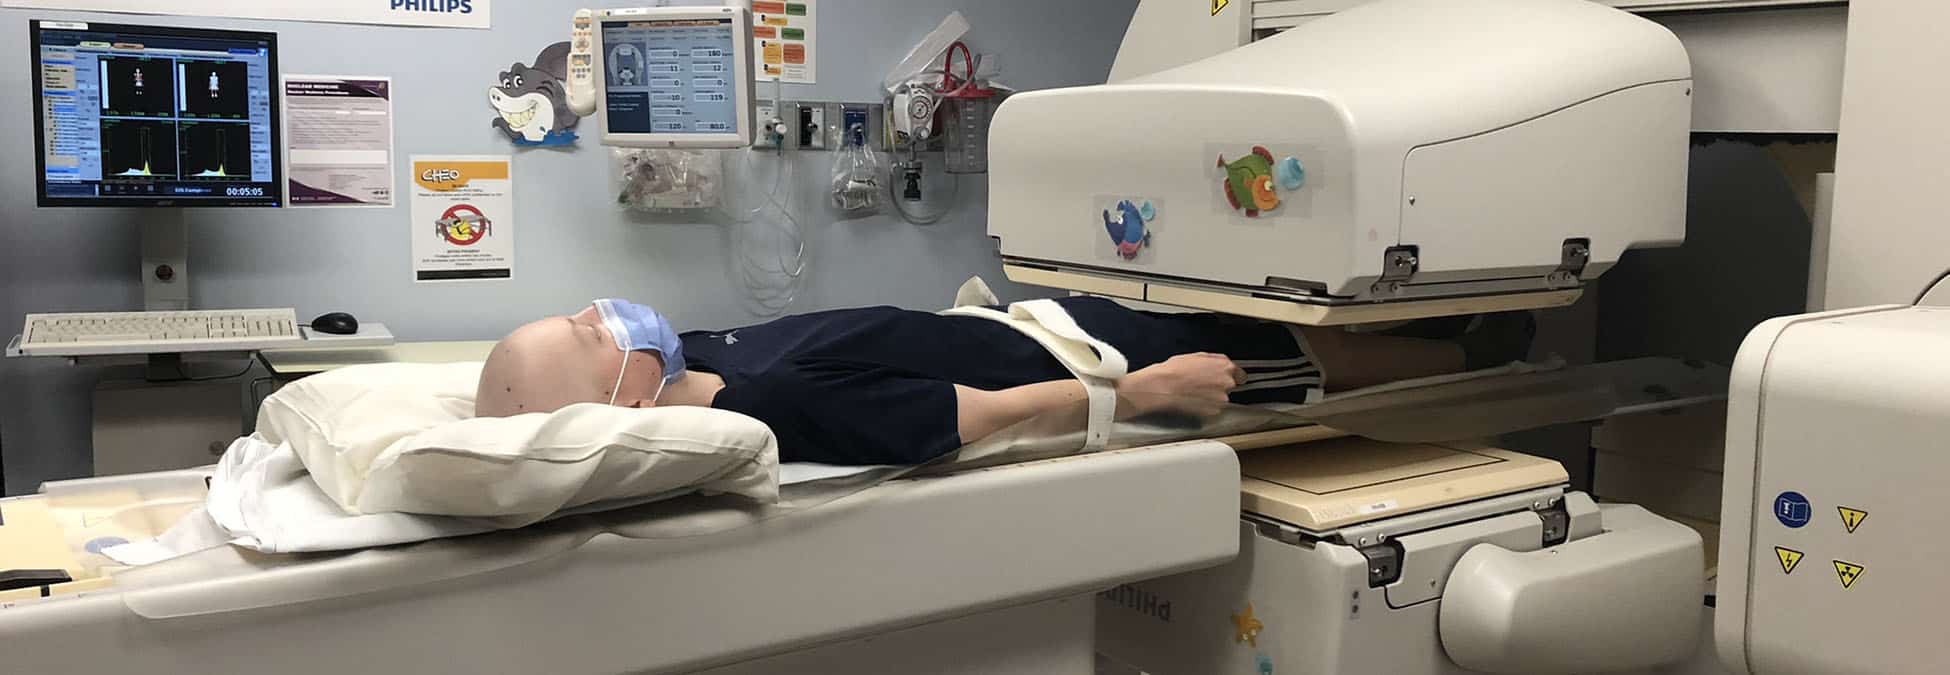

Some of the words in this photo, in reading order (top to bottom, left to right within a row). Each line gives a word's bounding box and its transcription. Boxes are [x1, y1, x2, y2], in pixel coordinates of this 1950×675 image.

[390, 0, 473, 14] PHILIPS
[422, 169, 460, 183] CHEO
[226, 187, 264, 196] 00:05:05
